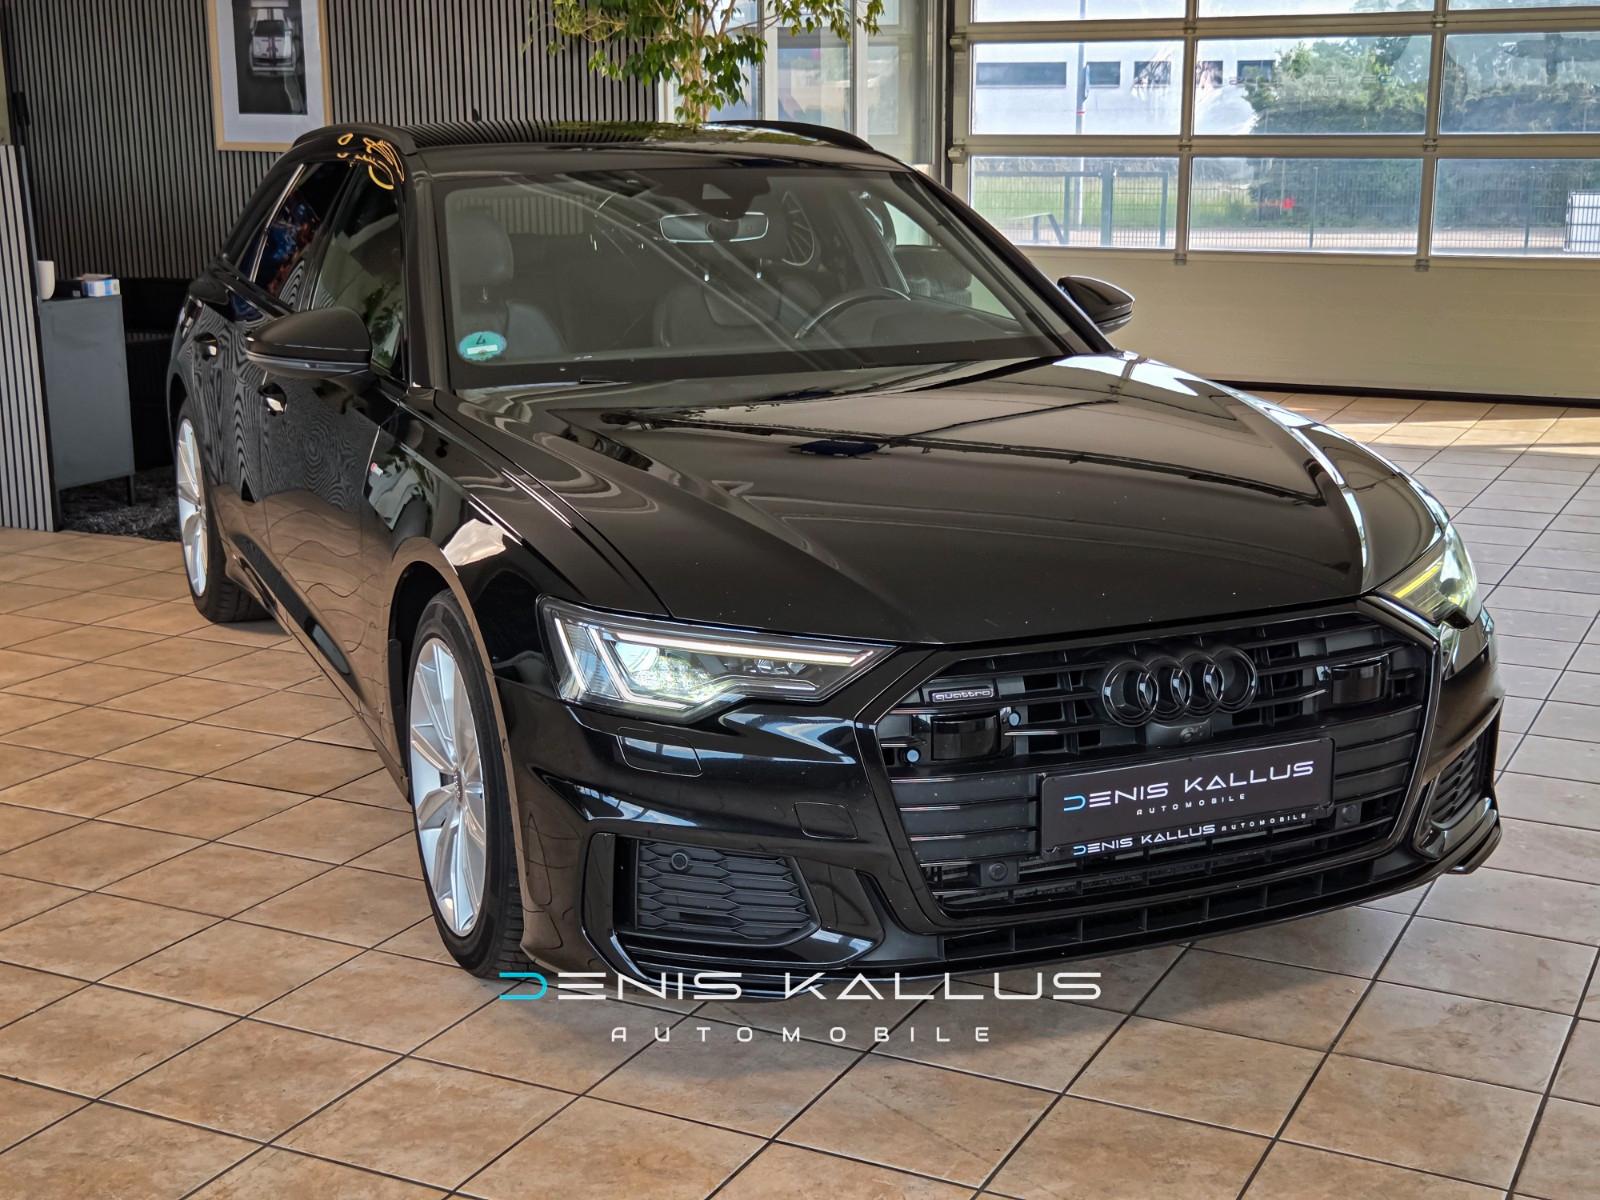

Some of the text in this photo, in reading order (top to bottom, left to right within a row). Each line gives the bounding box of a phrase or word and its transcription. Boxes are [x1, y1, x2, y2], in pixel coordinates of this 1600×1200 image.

[935, 689, 991, 701] quattro
[1063, 760, 1314, 812] DENIS KALLUS
[1136, 793, 1246, 816] AUTOMOBILE
[1073, 812, 1307, 856] DENIS KALLUS AUTOMOBILE
